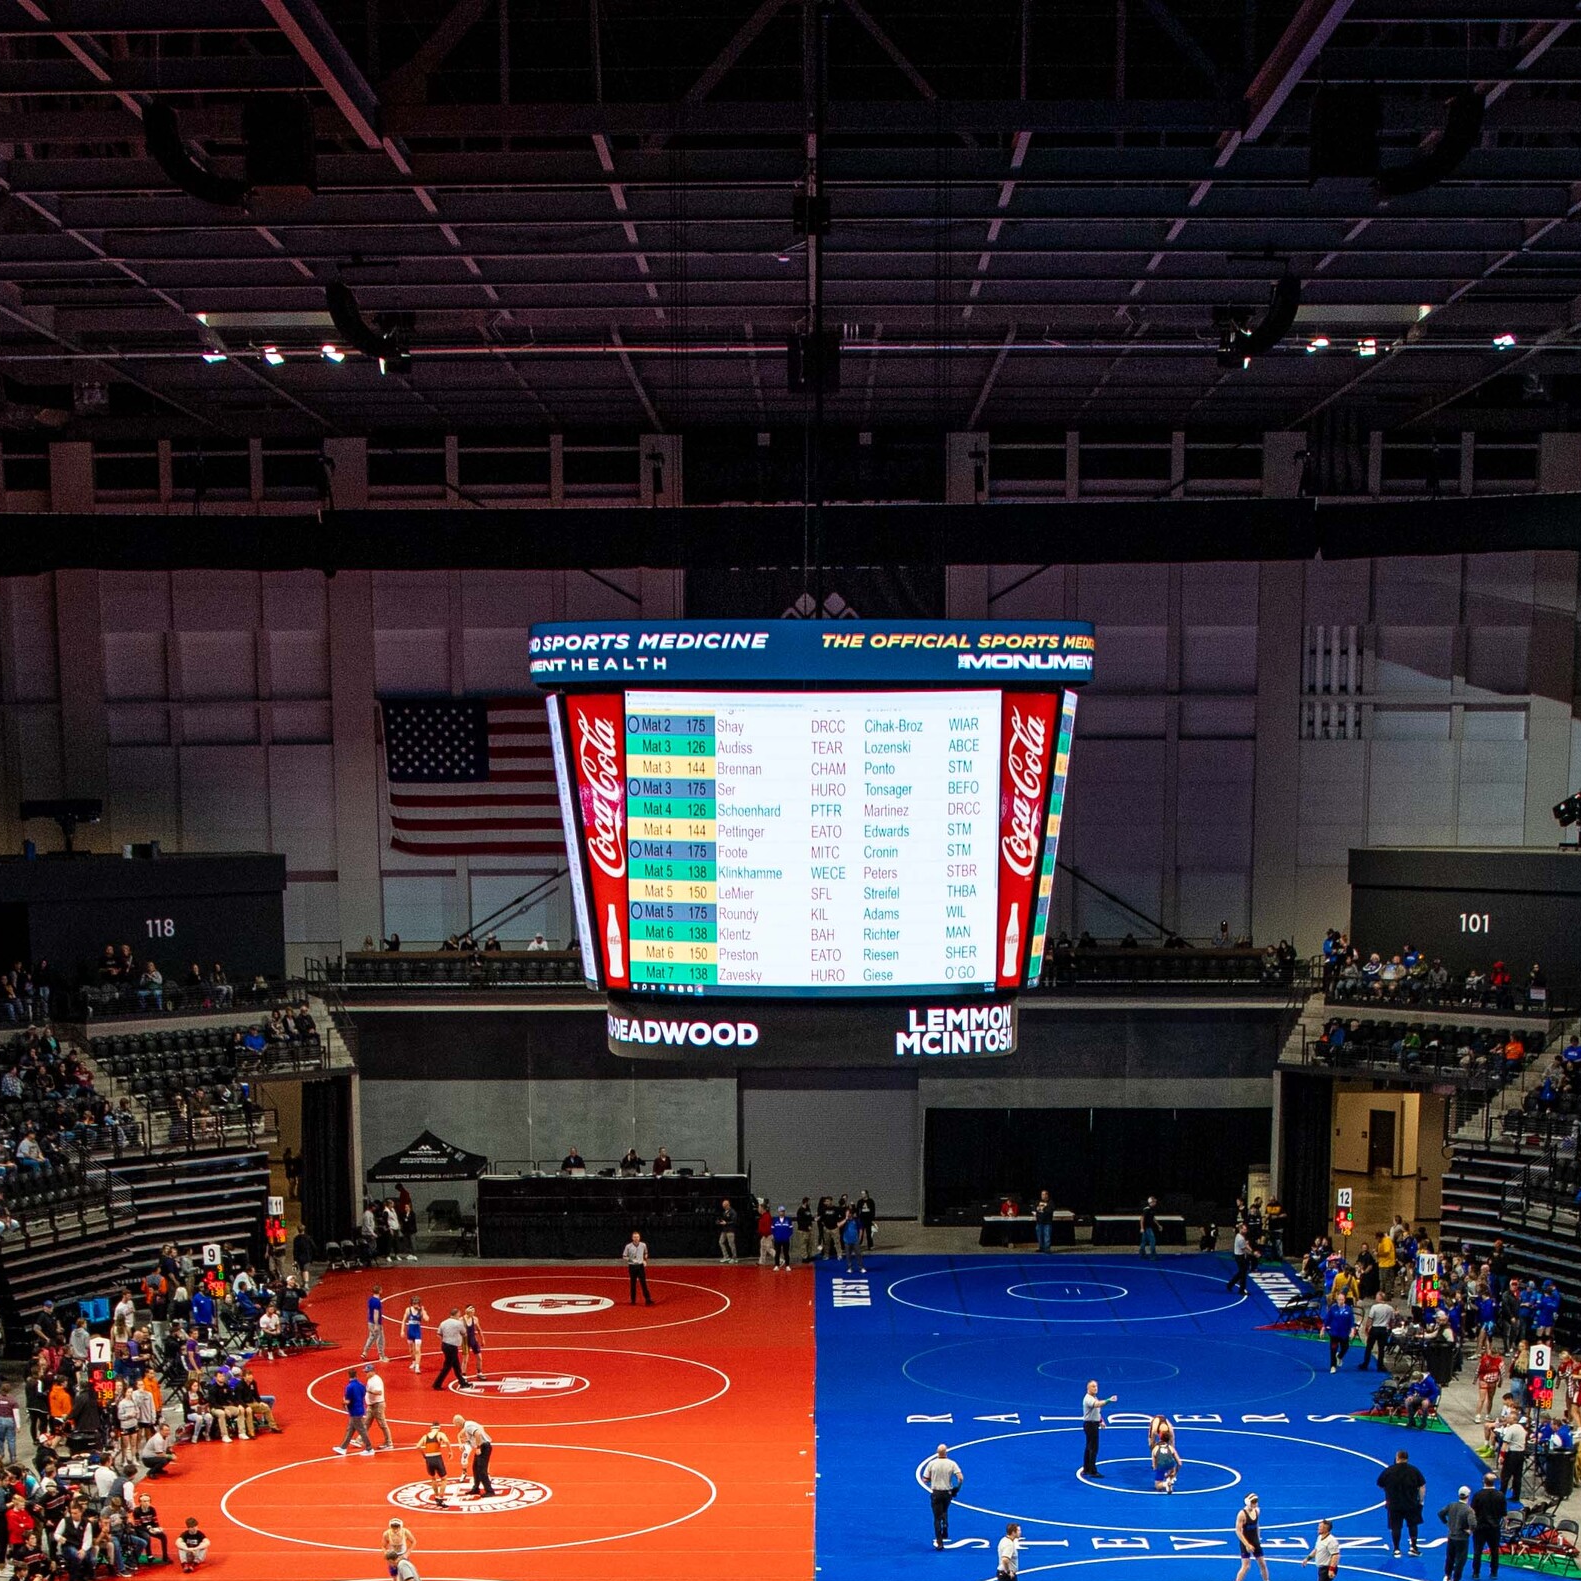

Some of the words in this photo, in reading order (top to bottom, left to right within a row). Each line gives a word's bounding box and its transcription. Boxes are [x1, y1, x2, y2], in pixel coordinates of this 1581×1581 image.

[543, 634, 630, 651] SPORTS
[638, 633, 769, 649] MEDICINE
[822, 634, 865, 648] THE
[870, 634, 971, 648] OFFICIAL
[978, 634, 1059, 649] SPORTS
[571, 657, 667, 671] HEALTH
[717, 720, 744, 736] Shay
[812, 720, 845, 733] DRCC
[865, 719, 922, 733] Cihak-Broz
[949, 718, 979, 731] WIAR
[717, 740, 753, 754] Audiss
[812, 741, 843, 754] TEAR
[865, 740, 911, 754] Lozenski
[949, 739, 979, 752] ABCE
[718, 762, 762, 775] Brennan
[811, 762, 846, 775] CHAM
[865, 762, 895, 774] Ponto
[949, 760, 972, 773] STM
[577, 707, 626, 878] Coca-Cola
[718, 785, 735, 796] Ser
[811, 783, 846, 796] HURO
[865, 783, 912, 798] Tonsager
[948, 781, 979, 794] BEFO
[1002, 705, 1045, 876] Coca-Cola
[719, 804, 780, 817] Schoenhard
[811, 804, 842, 817] PTFR
[865, 804, 909, 817] Martinez
[948, 802, 980, 815] DRCC
[719, 824, 764, 841] Pettinger
[811, 825, 842, 838] EATO
[865, 824, 909, 838] Edwards
[947, 823, 971, 836] STM
[719, 846, 748, 858] Foote
[811, 846, 839, 859] MITC
[864, 846, 898, 858] Cronin
[947, 844, 971, 856] STM
[719, 866, 782, 879] Klinkhamme
[811, 867, 845, 879] WECE
[864, 866, 897, 879] Peters
[947, 864, 977, 877] STBR
[719, 888, 753, 900] LeMier
[811, 888, 832, 900] SFL
[864, 887, 899, 900] Streifel
[947, 884, 976, 897] THBA
[719, 908, 758, 922] Roundy
[811, 908, 828, 920] KIL
[864, 908, 899, 920] Adams
[946, 905, 966, 918] WIL
[145, 917, 176, 940] 118
[1459, 912, 1491, 935] 101
[719, 928, 750, 940] Klentz
[811, 928, 834, 941] BAH
[864, 928, 899, 940] Richter
[946, 926, 970, 938] MAN
[720, 948, 758, 961] Preston
[811, 949, 841, 961] EATO
[864, 948, 899, 961] Riesen
[946, 946, 977, 959] SHER
[720, 969, 762, 984] Zavesky
[811, 969, 845, 981] HURO
[863, 969, 893, 981] Giese
[909, 1005, 1011, 1031] LEMMON
[896, 1027, 1013, 1055] MCINTOSH
[1340, 1191, 1349, 1205] 12
[208, 1249, 215, 1262] 9
[1427, 1259, 1435, 1273] 10
[832, 1278, 871, 1307] WEST
[96, 1344, 104, 1358] 7
[1536, 1350, 1544, 1366] 8
[906, 1412, 1354, 1424] RAIDERS
